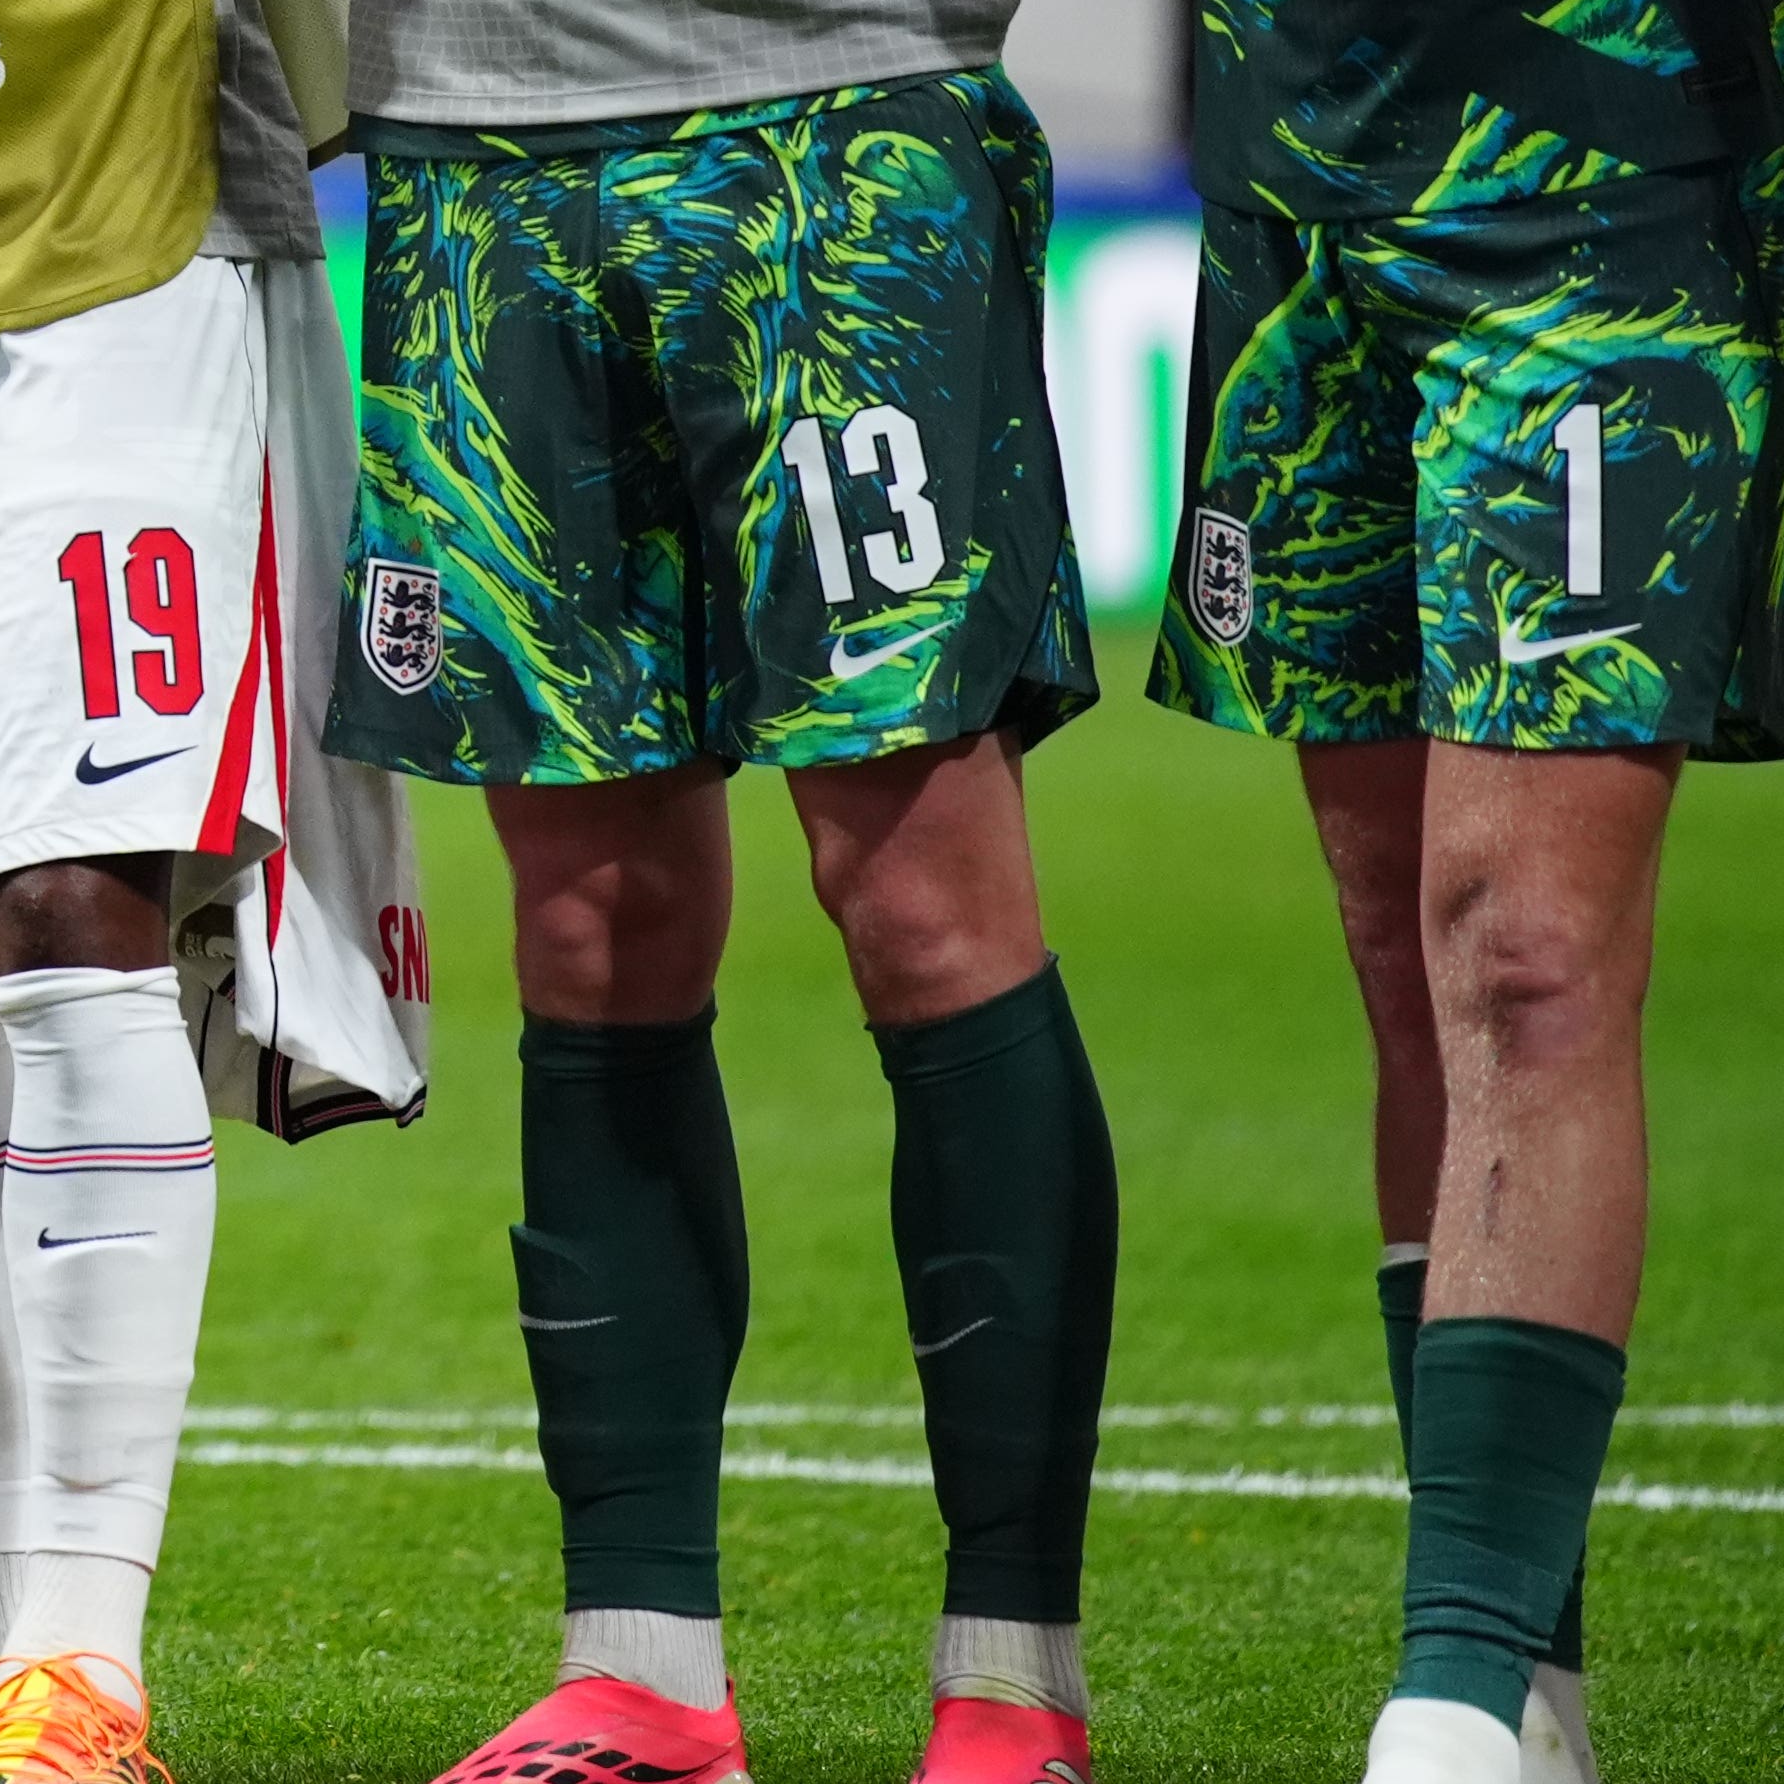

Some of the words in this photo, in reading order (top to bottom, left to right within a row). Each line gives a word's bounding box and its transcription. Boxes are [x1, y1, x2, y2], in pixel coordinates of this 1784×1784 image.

[780, 403, 946, 605] 13
[1554, 404, 1603, 596] 1
[57, 527, 204, 721] 19
